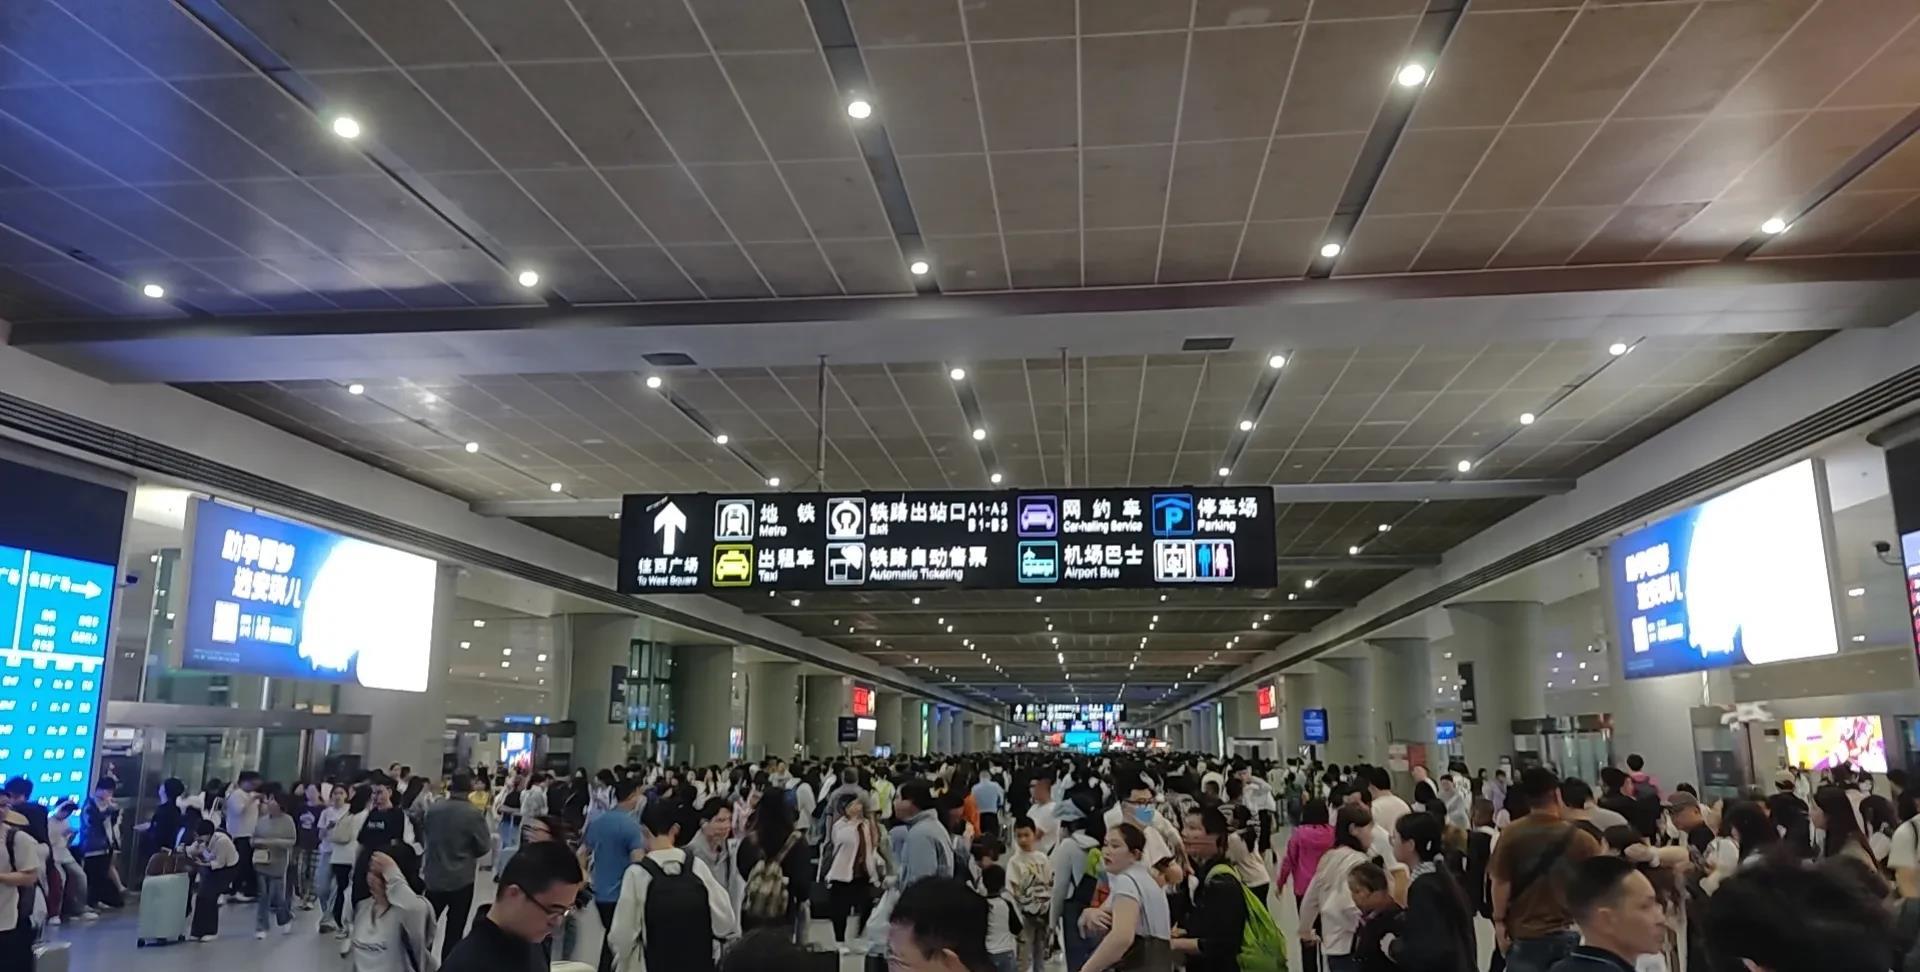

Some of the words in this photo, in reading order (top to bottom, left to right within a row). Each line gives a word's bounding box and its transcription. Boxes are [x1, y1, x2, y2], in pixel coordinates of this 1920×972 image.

[870, 502, 965, 522] 铁路出站口
[1063, 498, 1142, 520] 网约车
[1197, 497, 1258, 518] 停车场
[759, 524, 787, 537] Metro
[869, 522, 888, 535] Exit
[1110, 519, 1143, 532] Service
[1197, 519, 1237, 534] Parking
[758, 547, 815, 569] 出租车
[869, 546, 988, 568] 铁路自动售票
[1064, 543, 1144, 566] 机场巴士
[758, 569, 778, 582] Taxi
[869, 568, 918, 581] Automatic
[920, 568, 963, 582] Ticketing
[1064, 565, 1098, 580] Airport
[1100, 565, 1120, 579] Bus
[637, 575, 648, 586] To
[648, 575, 669, 586] West
[669, 575, 698, 587] Square
